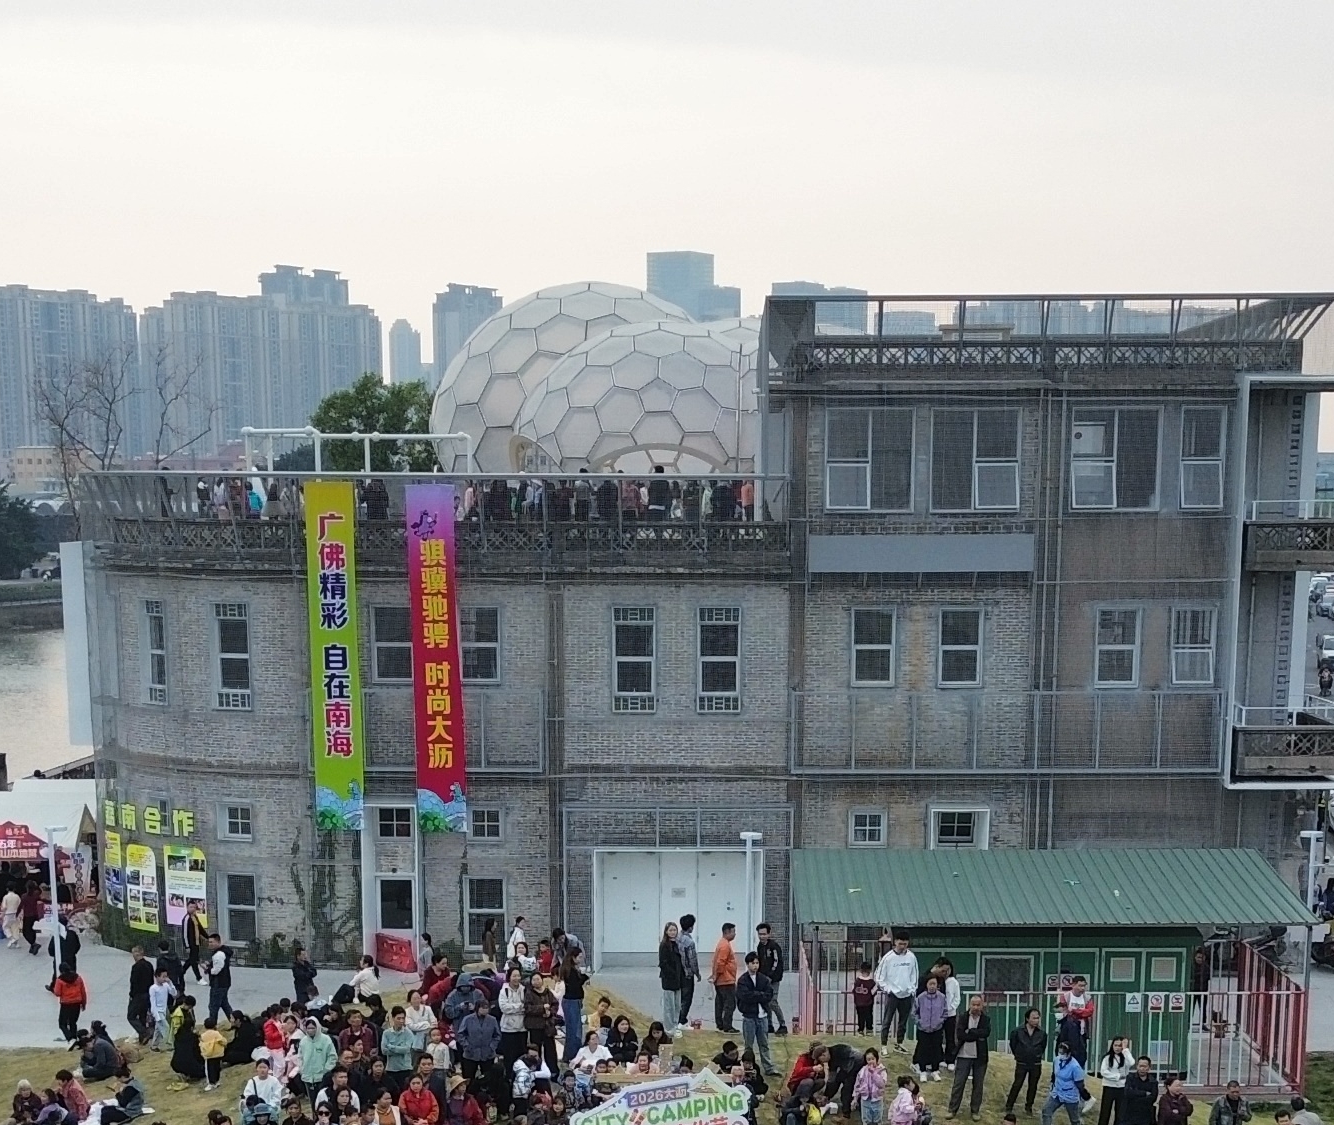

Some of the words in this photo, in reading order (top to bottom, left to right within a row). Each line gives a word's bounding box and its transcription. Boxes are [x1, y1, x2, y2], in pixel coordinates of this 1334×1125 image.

[318, 513, 349, 629] 广佛精彩
[420, 539, 450, 649] 骐骥驰骋
[323, 644, 354, 757] 自在南海
[425, 661, 453, 769] 时尚大沥
[646, 1093, 744, 1125] CAMPING
